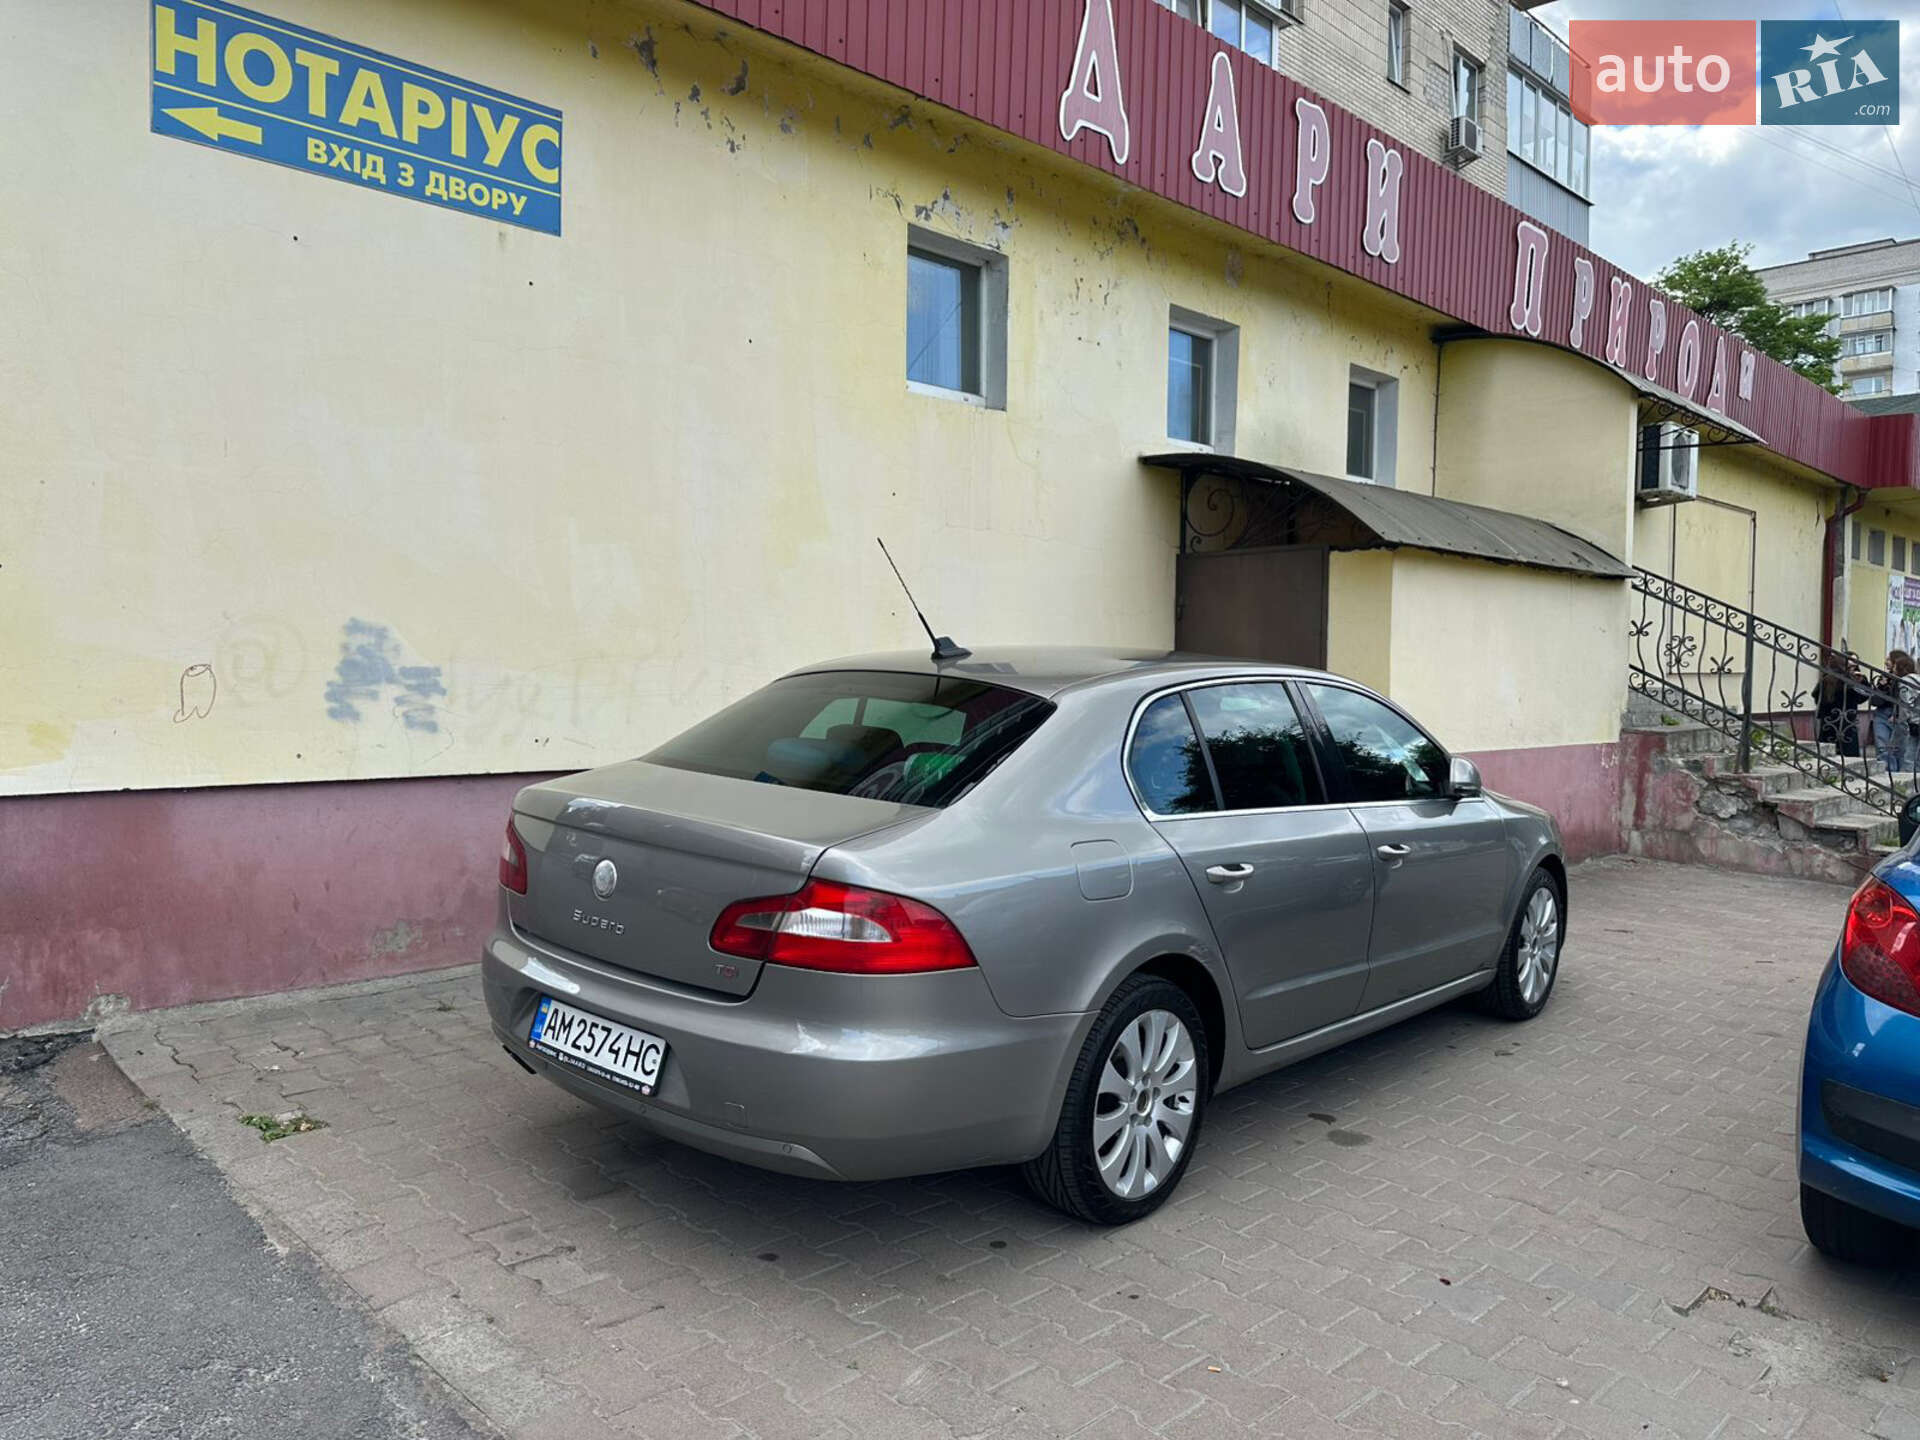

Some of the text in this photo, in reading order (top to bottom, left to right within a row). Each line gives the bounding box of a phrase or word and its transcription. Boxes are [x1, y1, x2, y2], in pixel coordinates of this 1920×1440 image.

[155, 4, 560, 184] НОТАРІУС
[306, 136, 387, 186] ВХІД
[425, 171, 528, 216] ДВОРУ
[1060, 0, 1403, 264] ДАРИ
[1510, 220, 1757, 413] ПРИРОДИ
